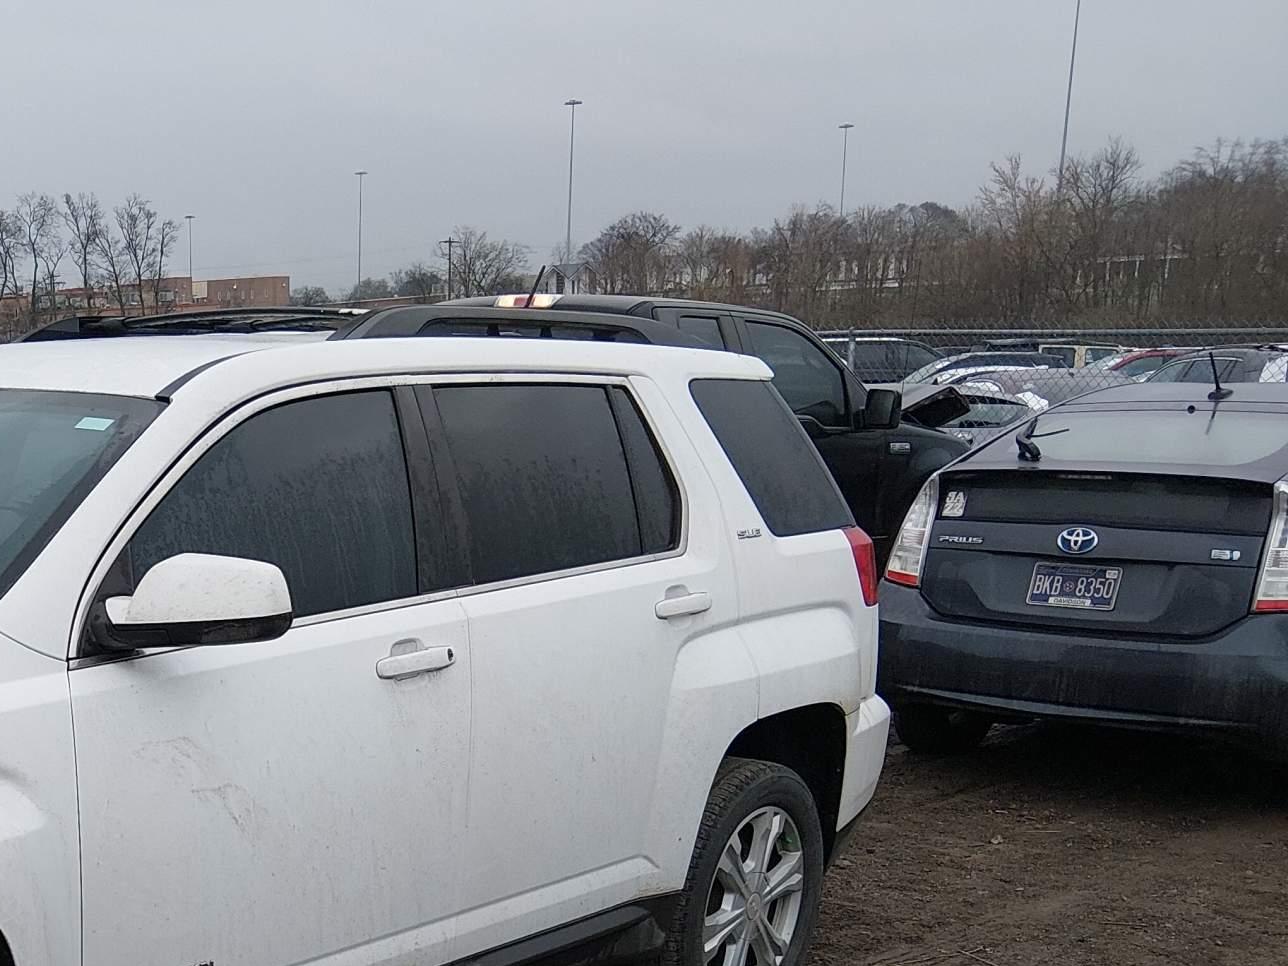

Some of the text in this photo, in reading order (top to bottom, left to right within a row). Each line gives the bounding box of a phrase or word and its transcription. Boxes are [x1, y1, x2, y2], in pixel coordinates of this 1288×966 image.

[938, 535, 984, 544] PRIUS
[1033, 575, 1114, 599] BKB 8350
